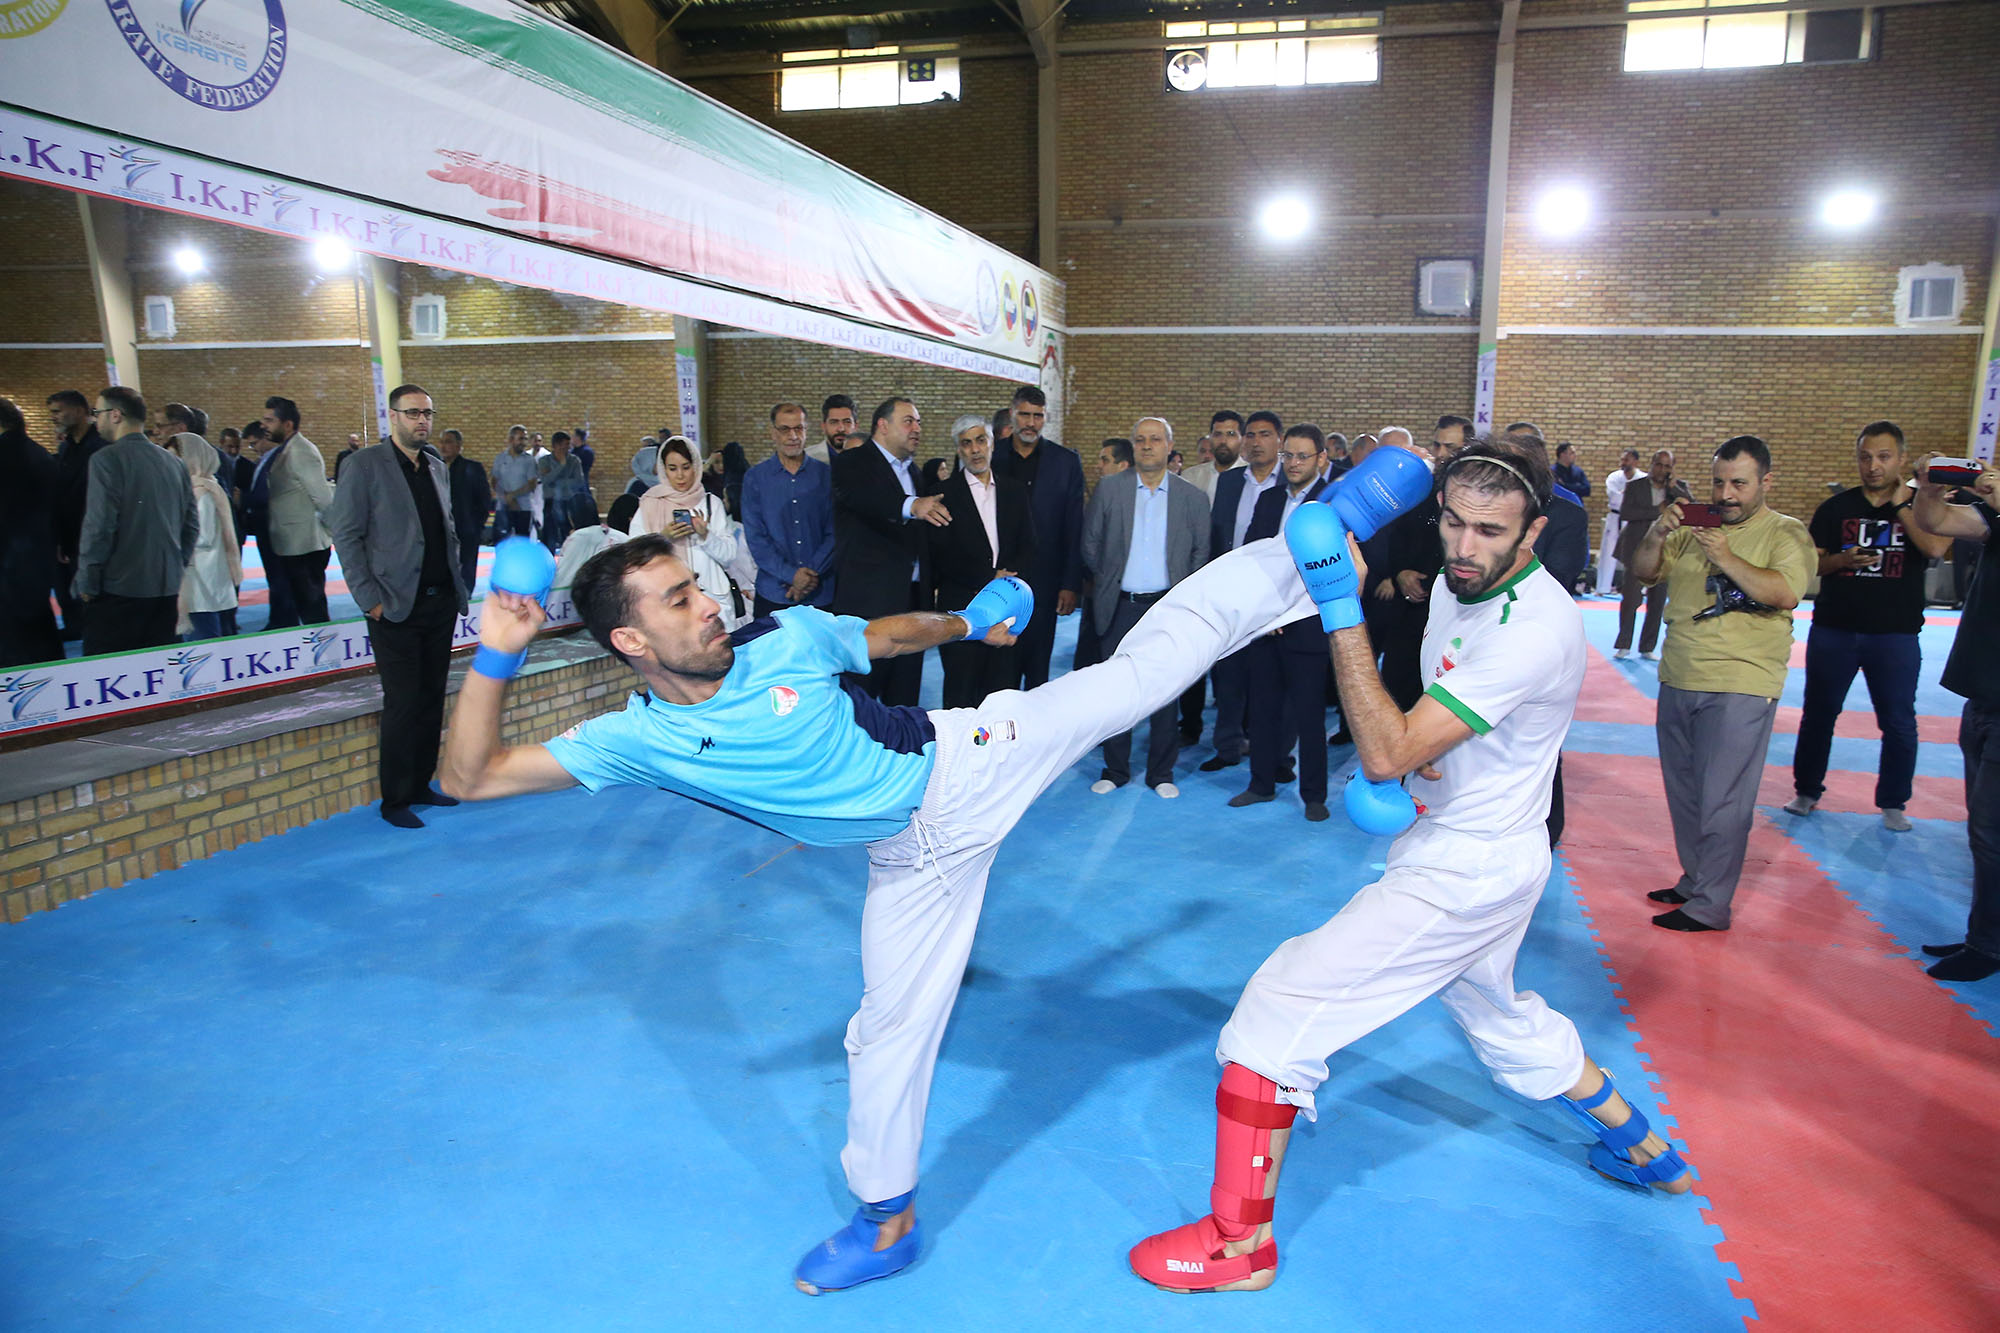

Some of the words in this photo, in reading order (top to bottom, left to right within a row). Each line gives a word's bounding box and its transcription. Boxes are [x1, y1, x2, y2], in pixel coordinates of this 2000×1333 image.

[108, 0, 175, 83] RATE
[184, 24, 285, 107] FEDERATION
[0, 130, 105, 182] .K.F
[170, 172, 261, 217] I.K.F
[309, 206, 380, 244] I.K.F
[419, 232, 477, 264] I.K.F
[1979, 388, 1997, 460] I.K.
[1304, 552, 1342, 571] SMAI
[221, 646, 301, 683] I.K.F
[63, 668, 166, 711] I.K.F
[1166, 1259, 1205, 1274] SMAI
